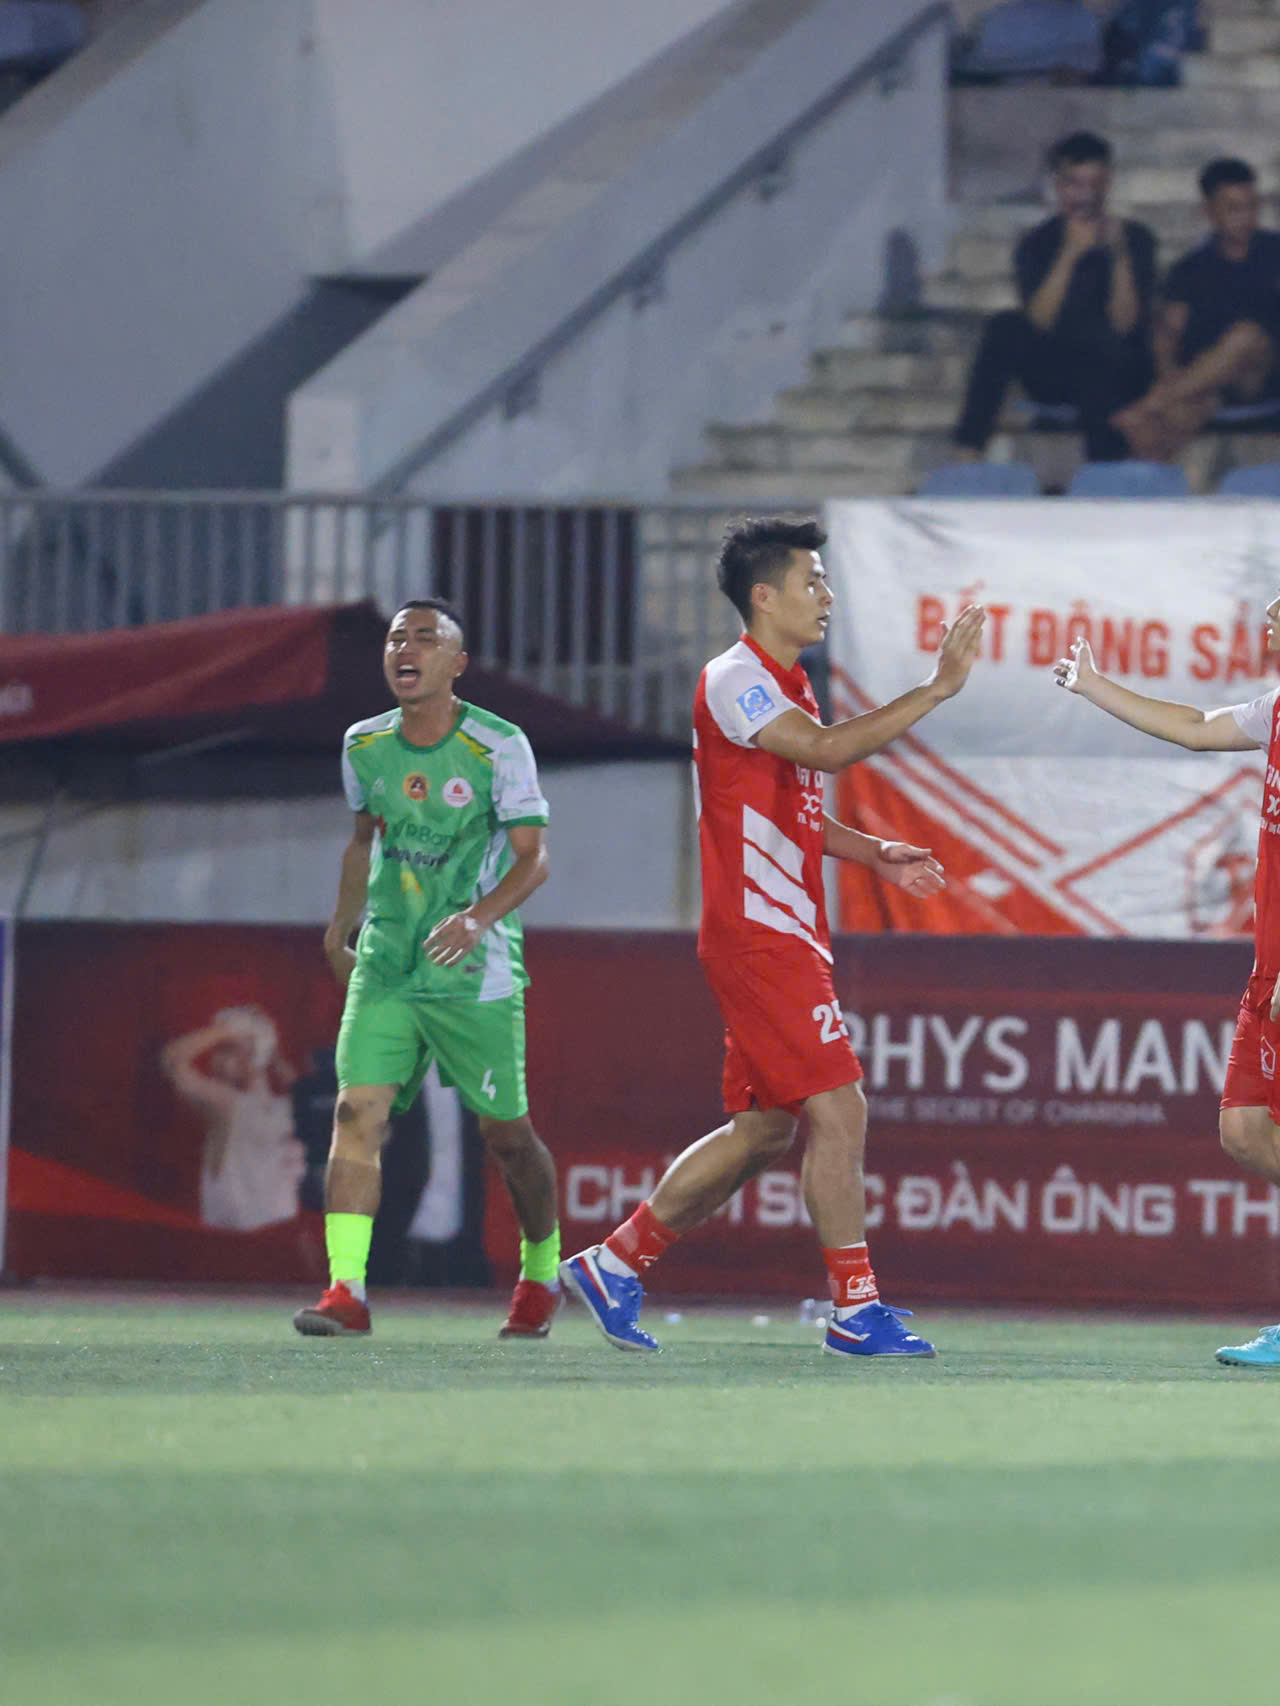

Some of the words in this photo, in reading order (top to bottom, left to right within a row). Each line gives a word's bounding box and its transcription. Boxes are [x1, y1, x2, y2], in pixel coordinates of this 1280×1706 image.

[481, 1068, 497, 1102] 4
[1055, 1015, 1238, 1094] MAN
[1041, 1163, 1176, 1235] ÔNG
